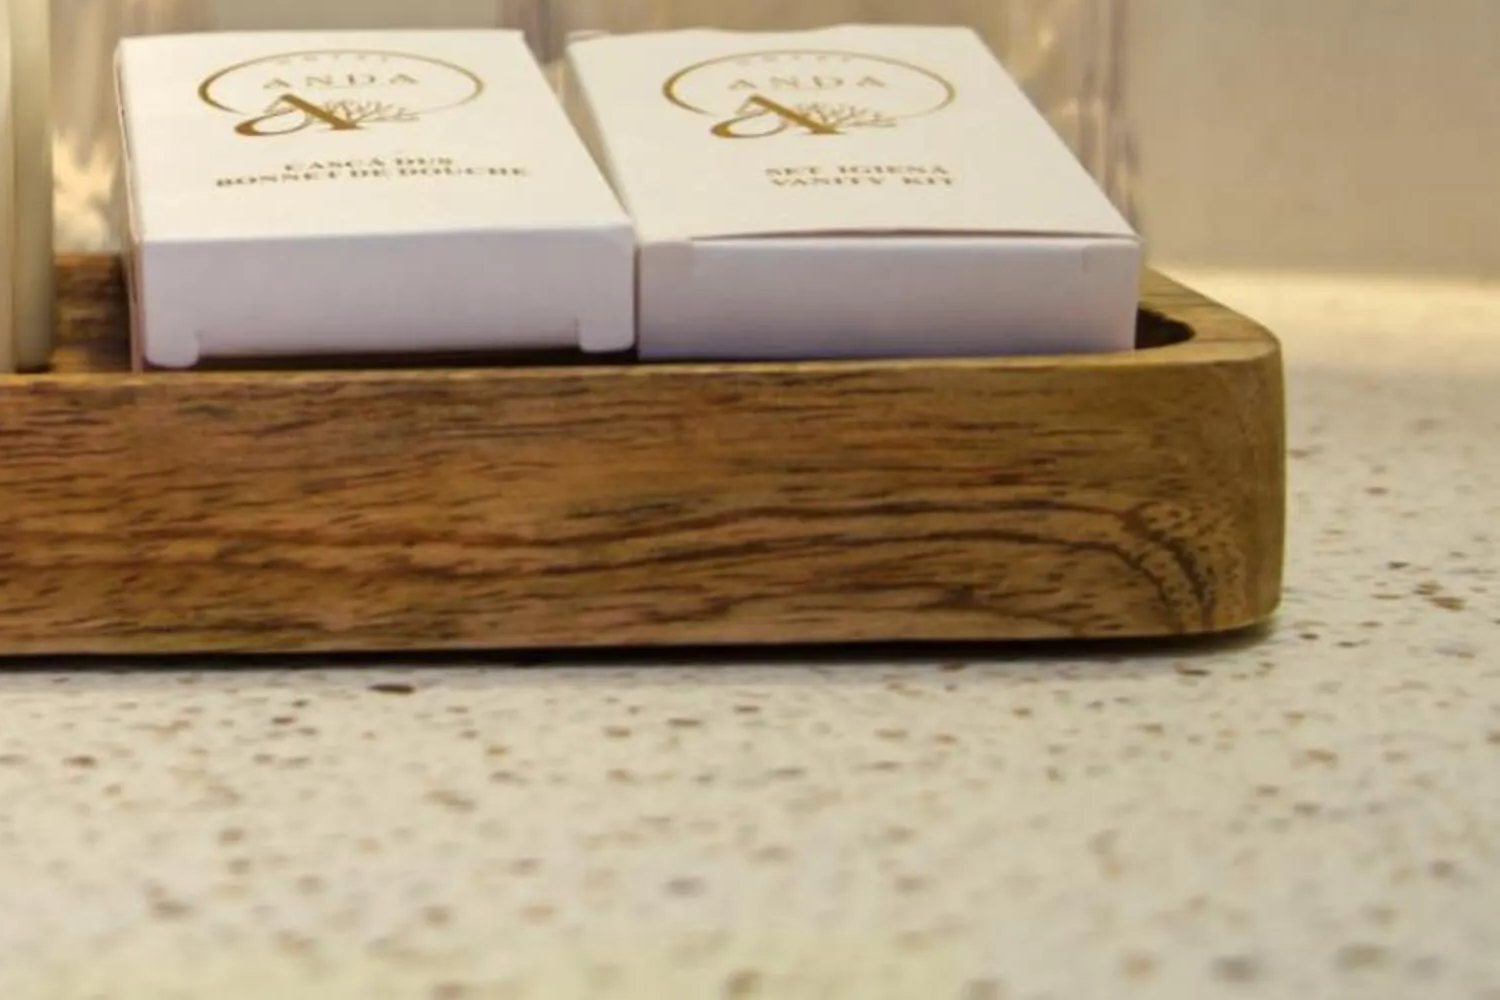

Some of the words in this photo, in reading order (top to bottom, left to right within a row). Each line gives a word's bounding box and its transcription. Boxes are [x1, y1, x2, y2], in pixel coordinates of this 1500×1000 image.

[263, 73, 419, 90] ANDA
[728, 75, 886, 91] ANDA
[216, 170, 338, 187] BONNET
[349, 169, 388, 178] DE
[399, 167, 527, 177] DOUCHE
[765, 166, 819, 176] SET
[771, 176, 885, 186] VANITY
[901, 176, 956, 186] KIT
